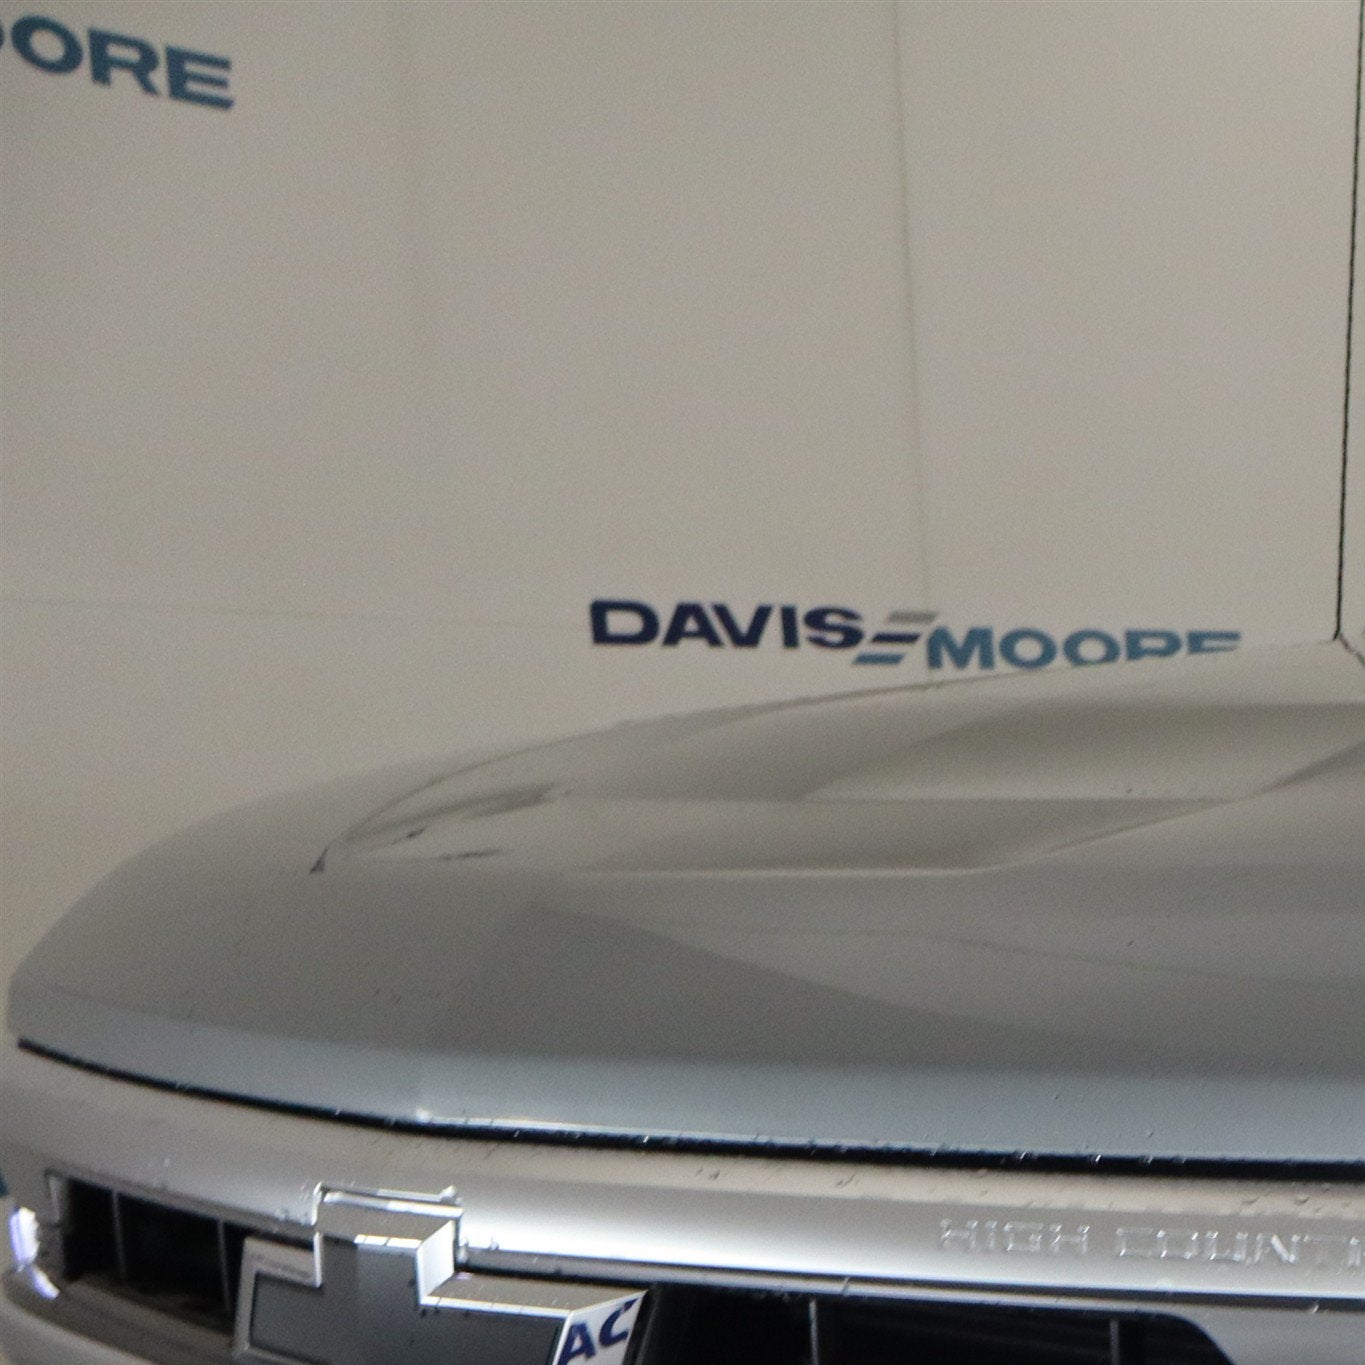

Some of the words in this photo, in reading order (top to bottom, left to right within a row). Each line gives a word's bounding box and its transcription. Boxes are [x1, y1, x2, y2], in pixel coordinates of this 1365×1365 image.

[0, 15, 234, 110] ORE
[590, 600, 861, 649] DAVIS
[939, 1218, 1092, 1255] HIGH
